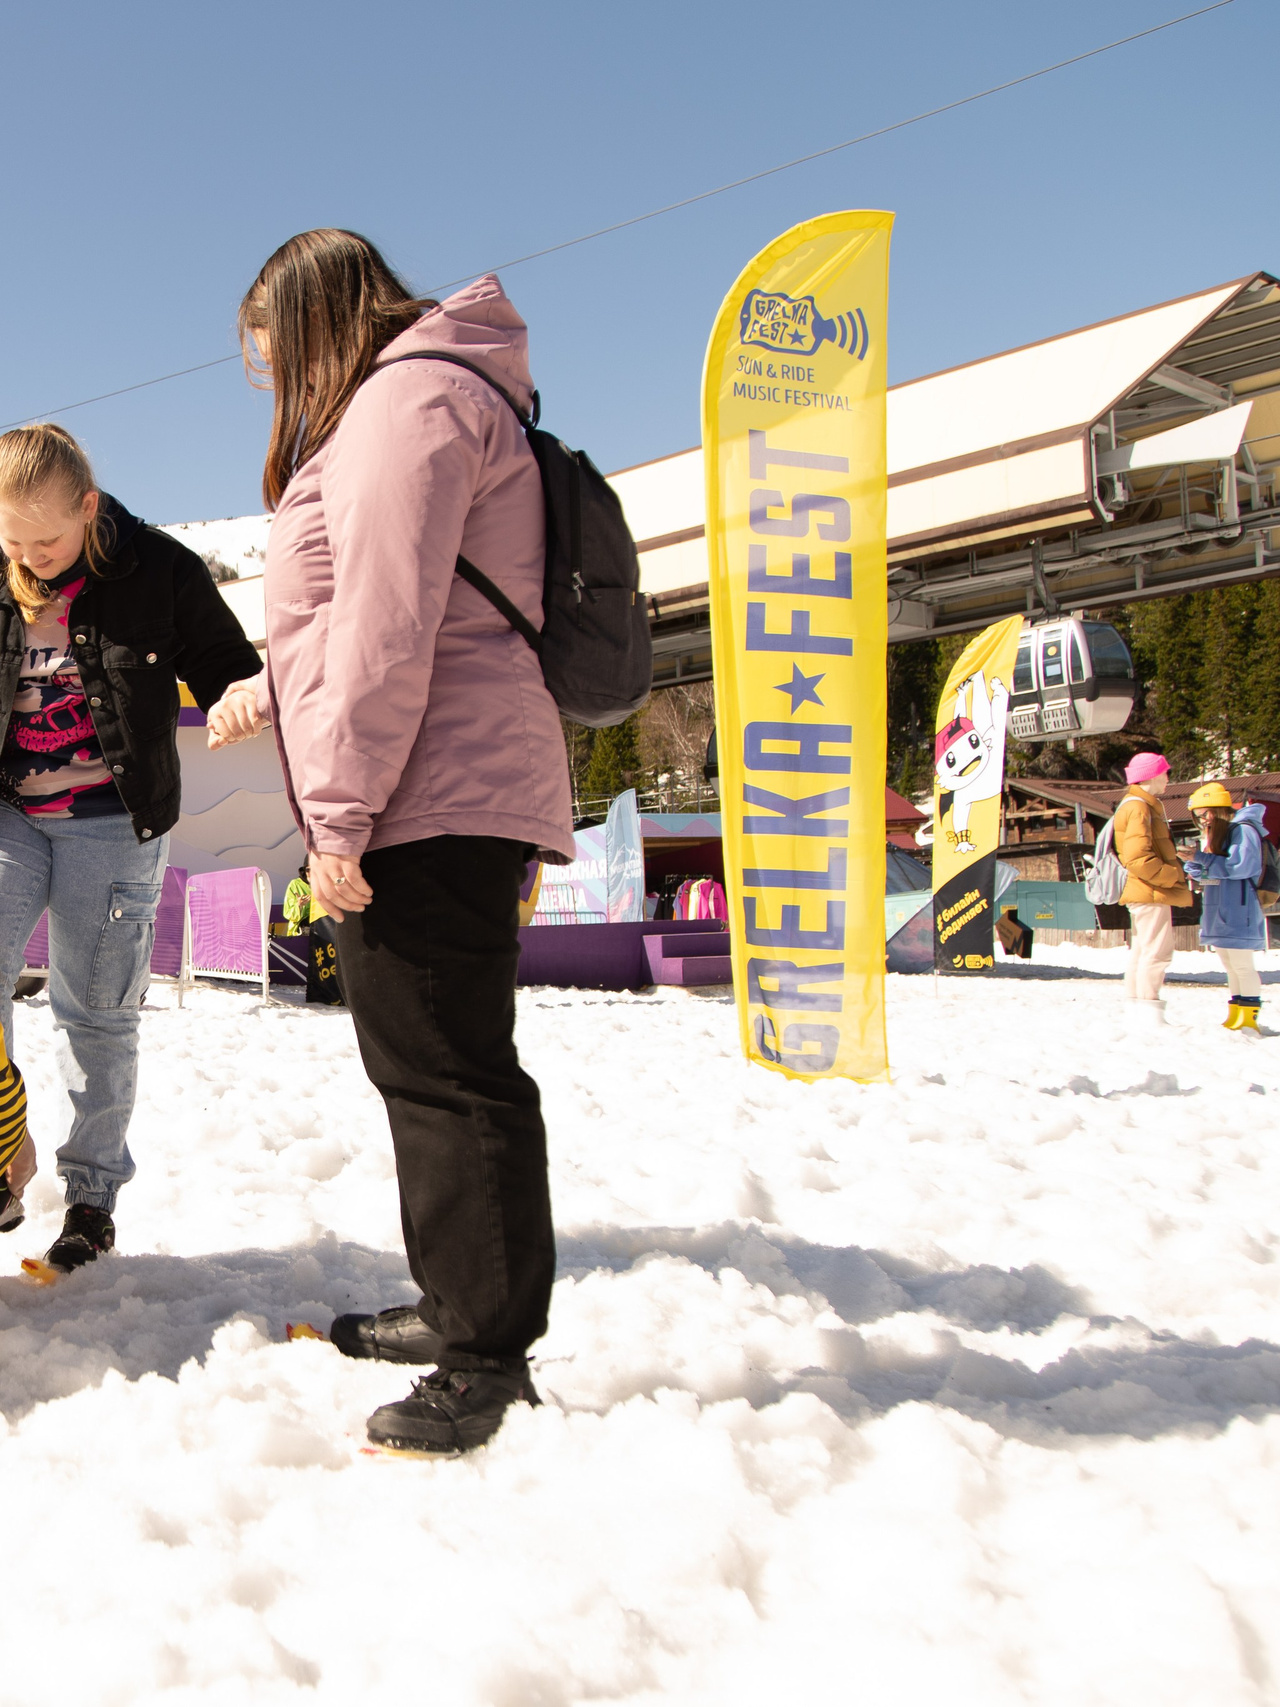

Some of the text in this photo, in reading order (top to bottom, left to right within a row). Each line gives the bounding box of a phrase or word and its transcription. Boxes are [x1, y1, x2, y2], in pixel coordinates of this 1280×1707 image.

[754, 299, 809, 326] GRELKA
[747, 319, 789, 344] FEST
[736, 355, 815, 383] SUN & RIDE
[733, 382, 853, 412] MUSIC FESTIVAL
[742, 428, 854, 1073] GRELKA FEST
[542, 858, 607, 883] ОЛЫЖНАЯ
